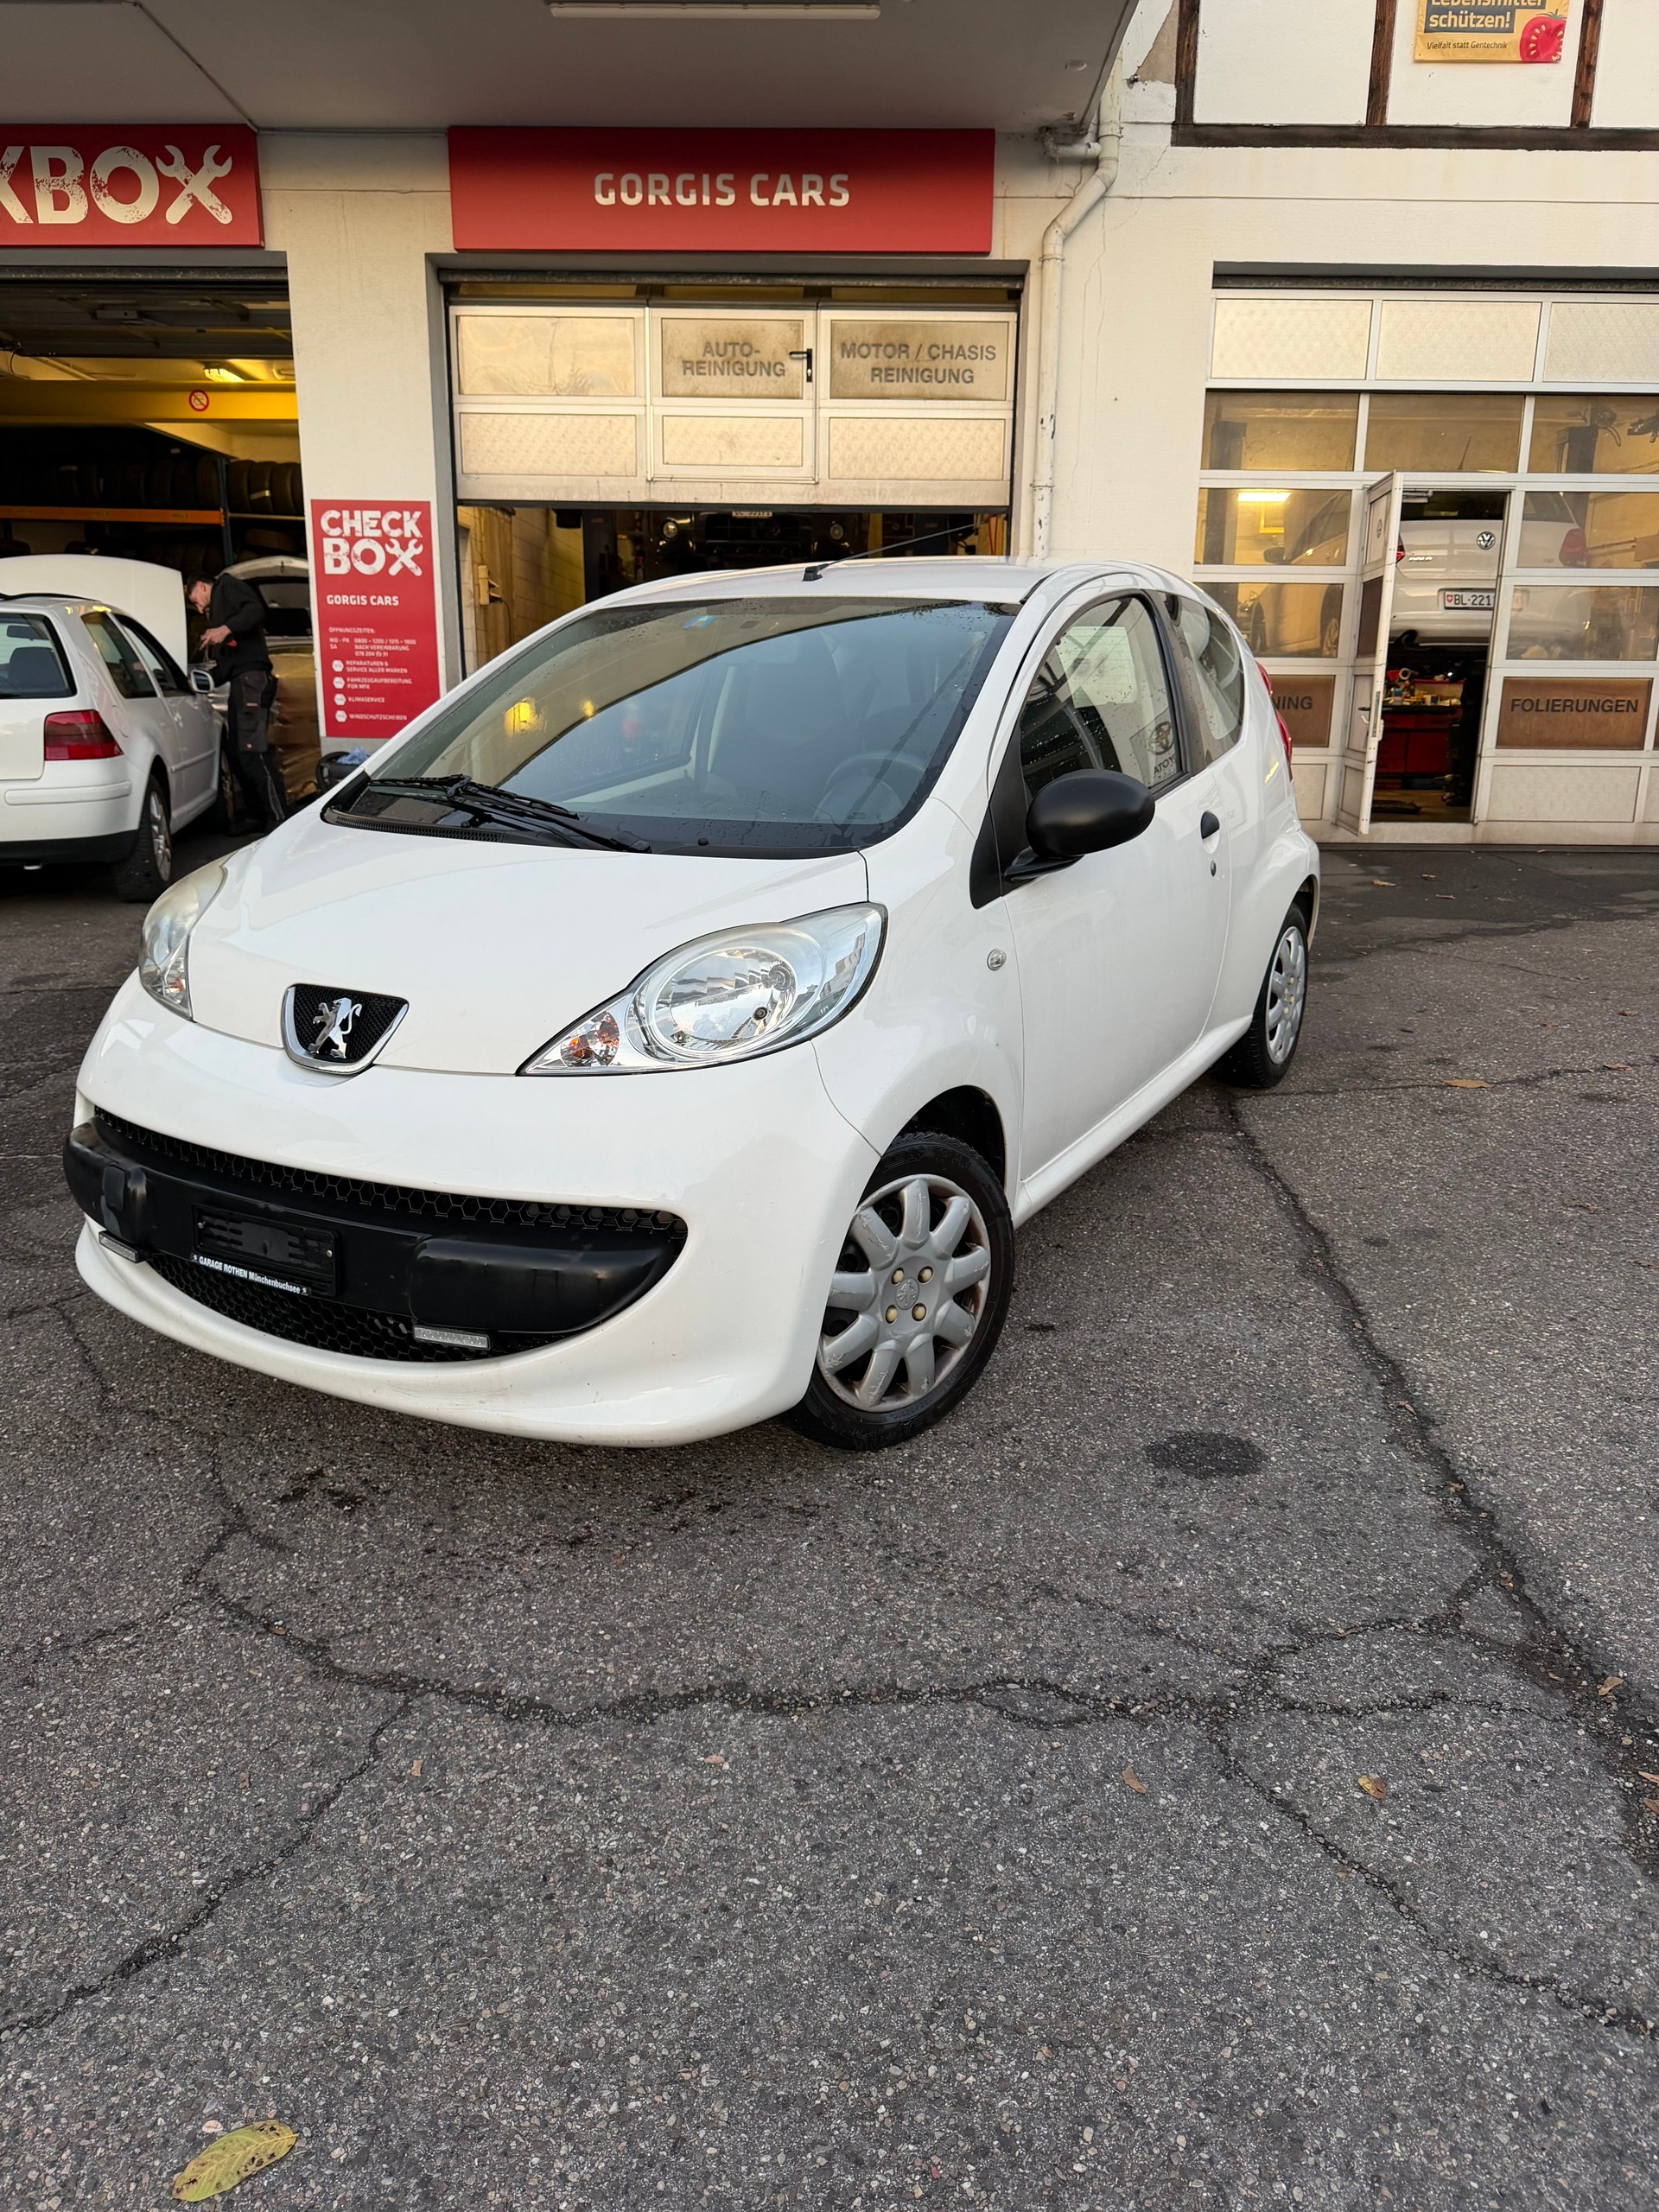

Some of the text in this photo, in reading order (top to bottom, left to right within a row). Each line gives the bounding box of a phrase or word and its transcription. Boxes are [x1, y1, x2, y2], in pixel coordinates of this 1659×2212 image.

[1429, 10, 1511, 29] schützen!
[1427, 41, 1451, 50] Vielfalt
[1471, 41, 1508, 49] Gentechnik
[594, 173, 849, 207] GORGIS CARS
[702, 341, 760, 358] AUTO-
[840, 342, 911, 359] MOTOR
[928, 344, 997, 361] CHASIS
[682, 359, 785, 378] REINIGUNG
[871, 366, 975, 384] REINIGUNG
[321, 510, 423, 537] CHECK
[323, 537, 423, 576] BOX
[327, 594, 399, 606] GORGIS CARS
[1510, 698, 1638, 713] FOLIERUNGEN
[199, 1256, 301, 1294] GARAGE ROTHEN Münchenbuchsee
